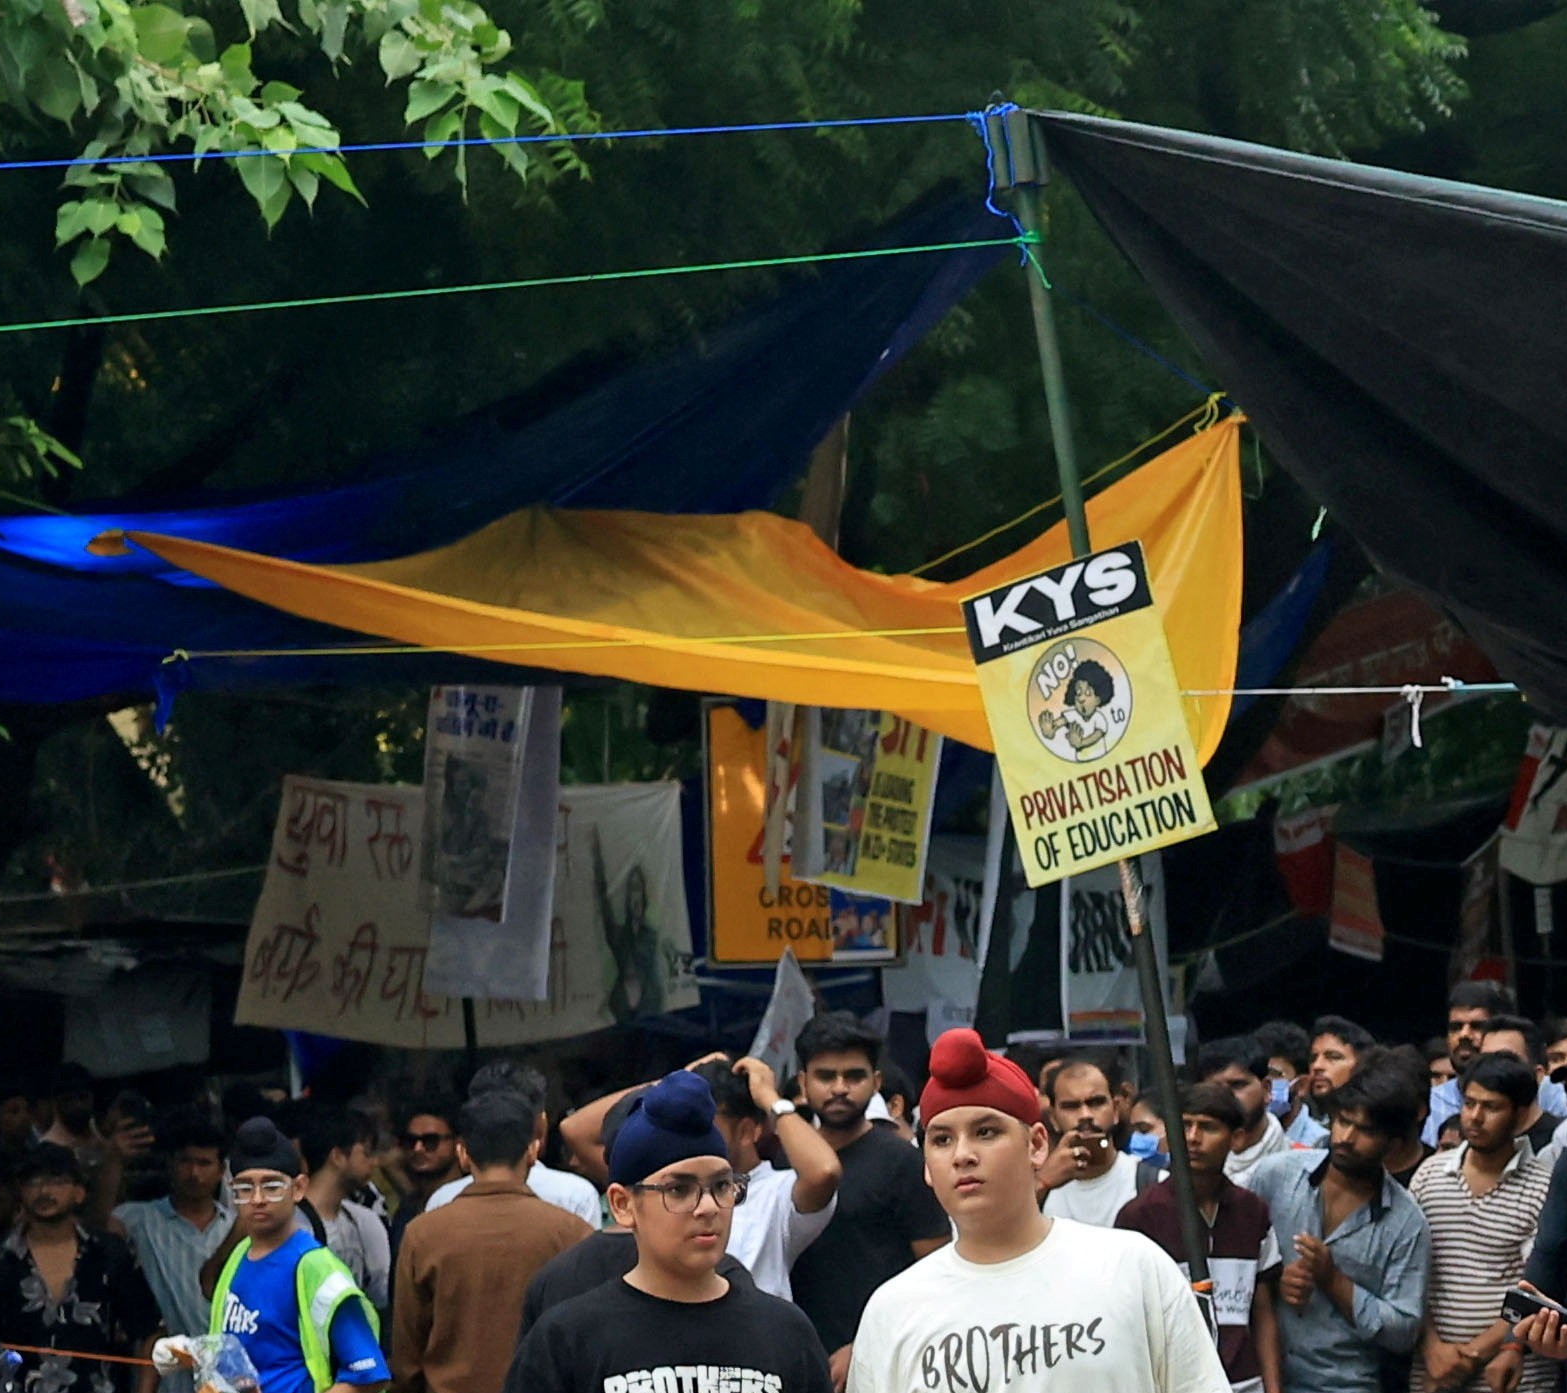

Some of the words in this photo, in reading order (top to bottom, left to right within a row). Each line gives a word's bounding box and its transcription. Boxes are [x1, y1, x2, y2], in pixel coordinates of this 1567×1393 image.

[973, 551, 1137, 648] KYS
[1068, 605, 1120, 630] Sangathan
[1036, 643, 1079, 700] NO!
[1111, 708, 1125, 725] to
[1020, 744, 1187, 830] PRIVATISATION
[1034, 831, 1061, 872] OF
[1068, 788, 1197, 862] EDUCATION
[759, 884, 829, 909] CROS
[767, 917, 831, 941] ROA
